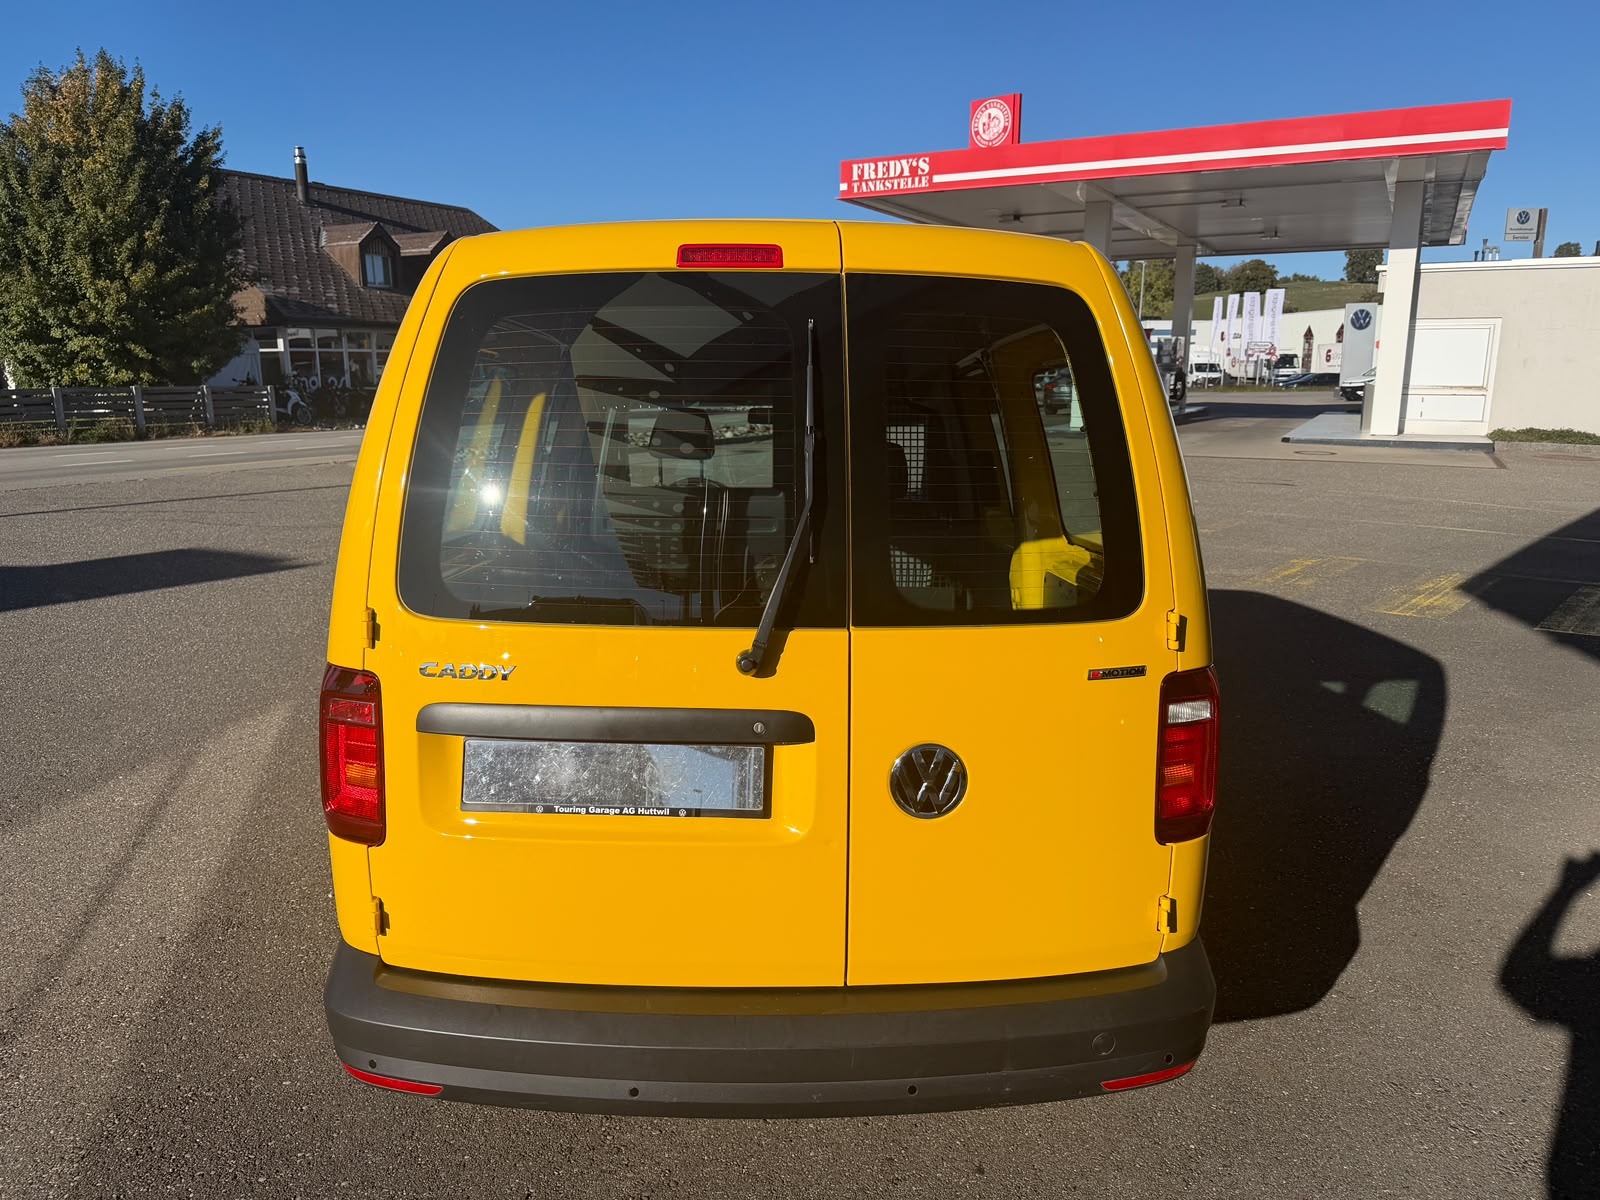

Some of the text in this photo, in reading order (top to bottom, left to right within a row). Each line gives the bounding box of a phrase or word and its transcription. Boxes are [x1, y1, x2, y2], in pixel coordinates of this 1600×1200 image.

[852, 157, 930, 181] FREDY'S
[852, 176, 929, 193] TANKSTELLE
[419, 662, 517, 681] CADDY
[554, 805, 586, 814] Touring
[589, 806, 620, 816] Garage
[622, 807, 636, 815] AG
[637, 807, 670, 816] Huttwil
